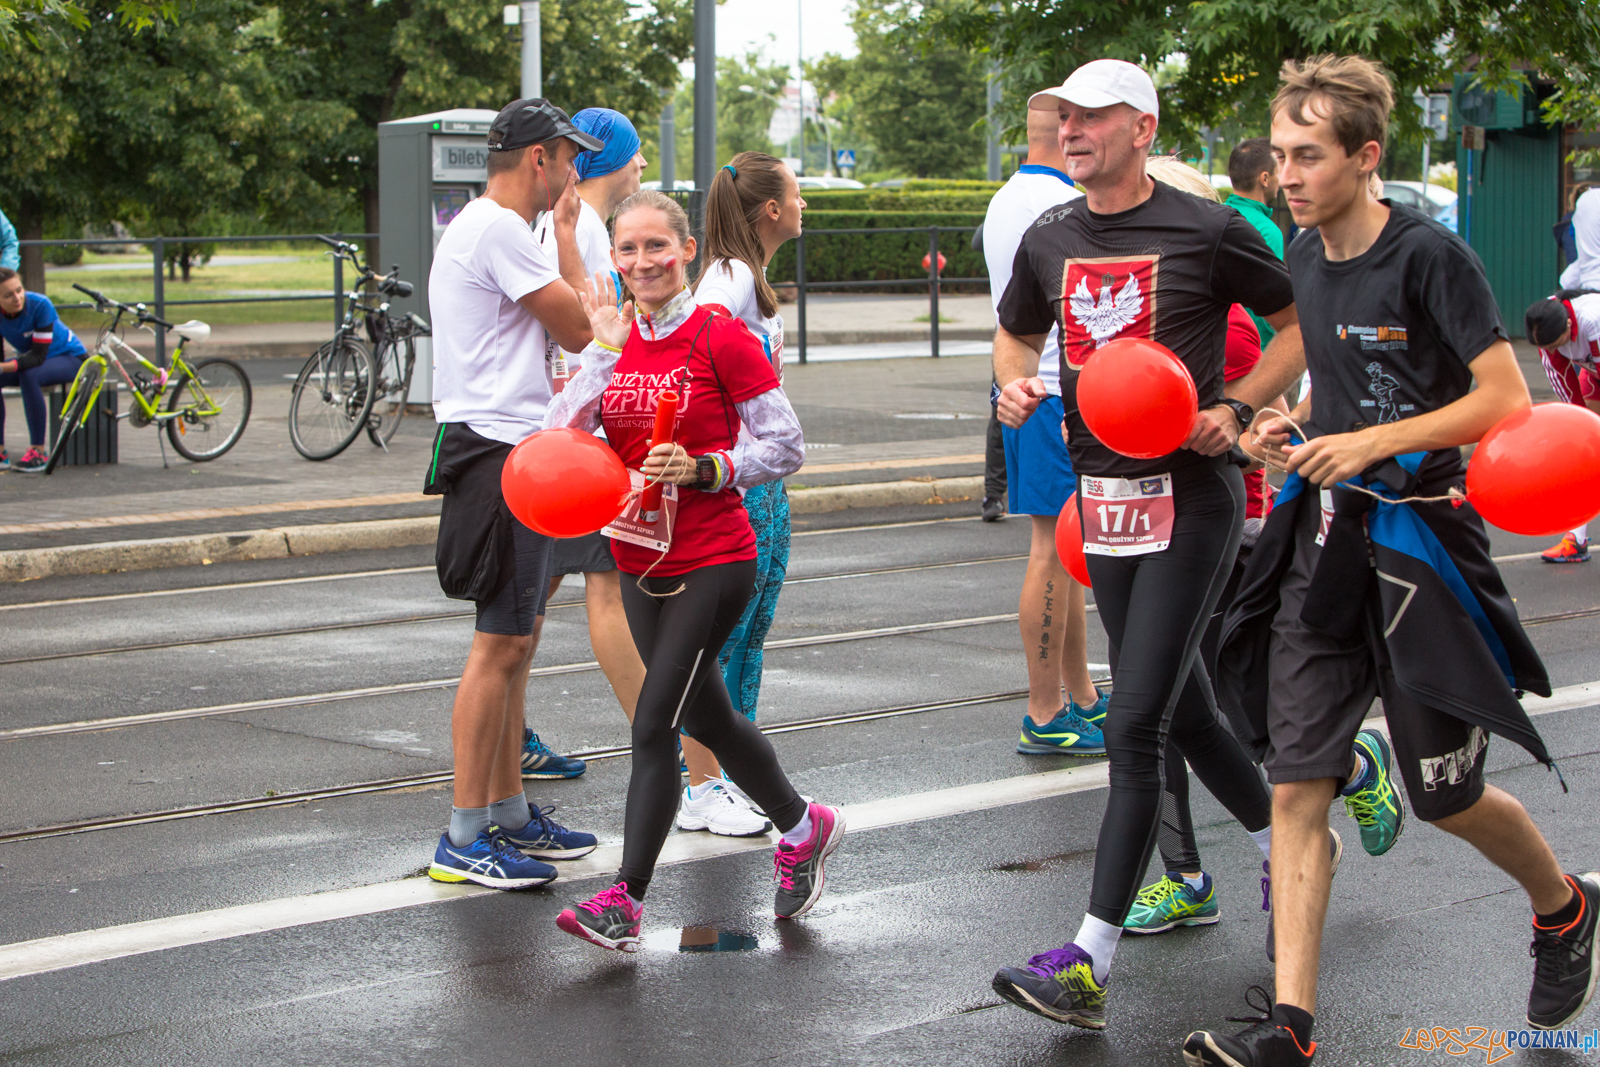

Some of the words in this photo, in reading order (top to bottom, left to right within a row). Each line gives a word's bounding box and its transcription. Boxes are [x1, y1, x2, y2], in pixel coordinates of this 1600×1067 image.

[449, 149, 487, 168] bilety
[610, 371, 672, 388] RUŻYNA
[1094, 481, 1104, 493] 56
[1096, 504, 1151, 533] 17/1
